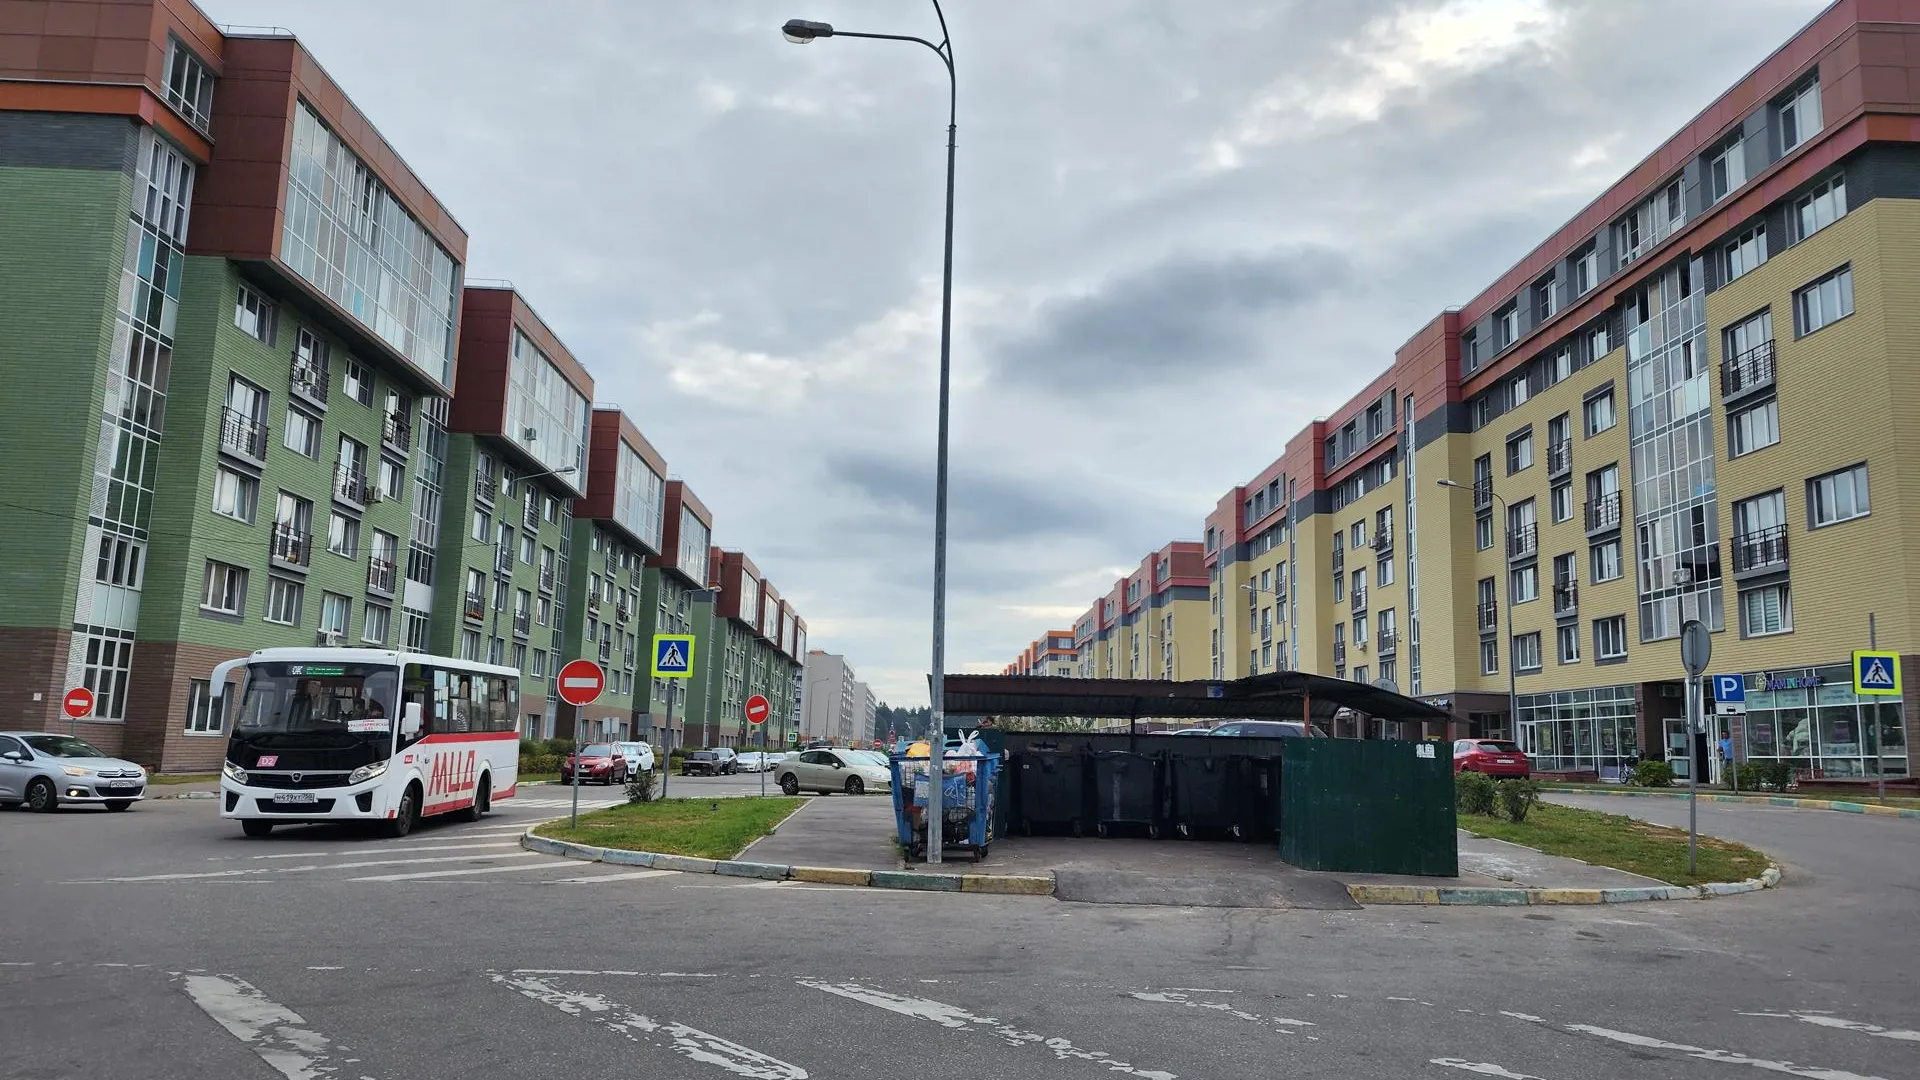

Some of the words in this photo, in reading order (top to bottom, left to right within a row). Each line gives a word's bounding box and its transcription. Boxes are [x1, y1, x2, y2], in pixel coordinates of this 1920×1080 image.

[1720, 677, 1738, 700] P
[261, 757, 274, 765] D2
[428, 750, 475, 796] МЦД
